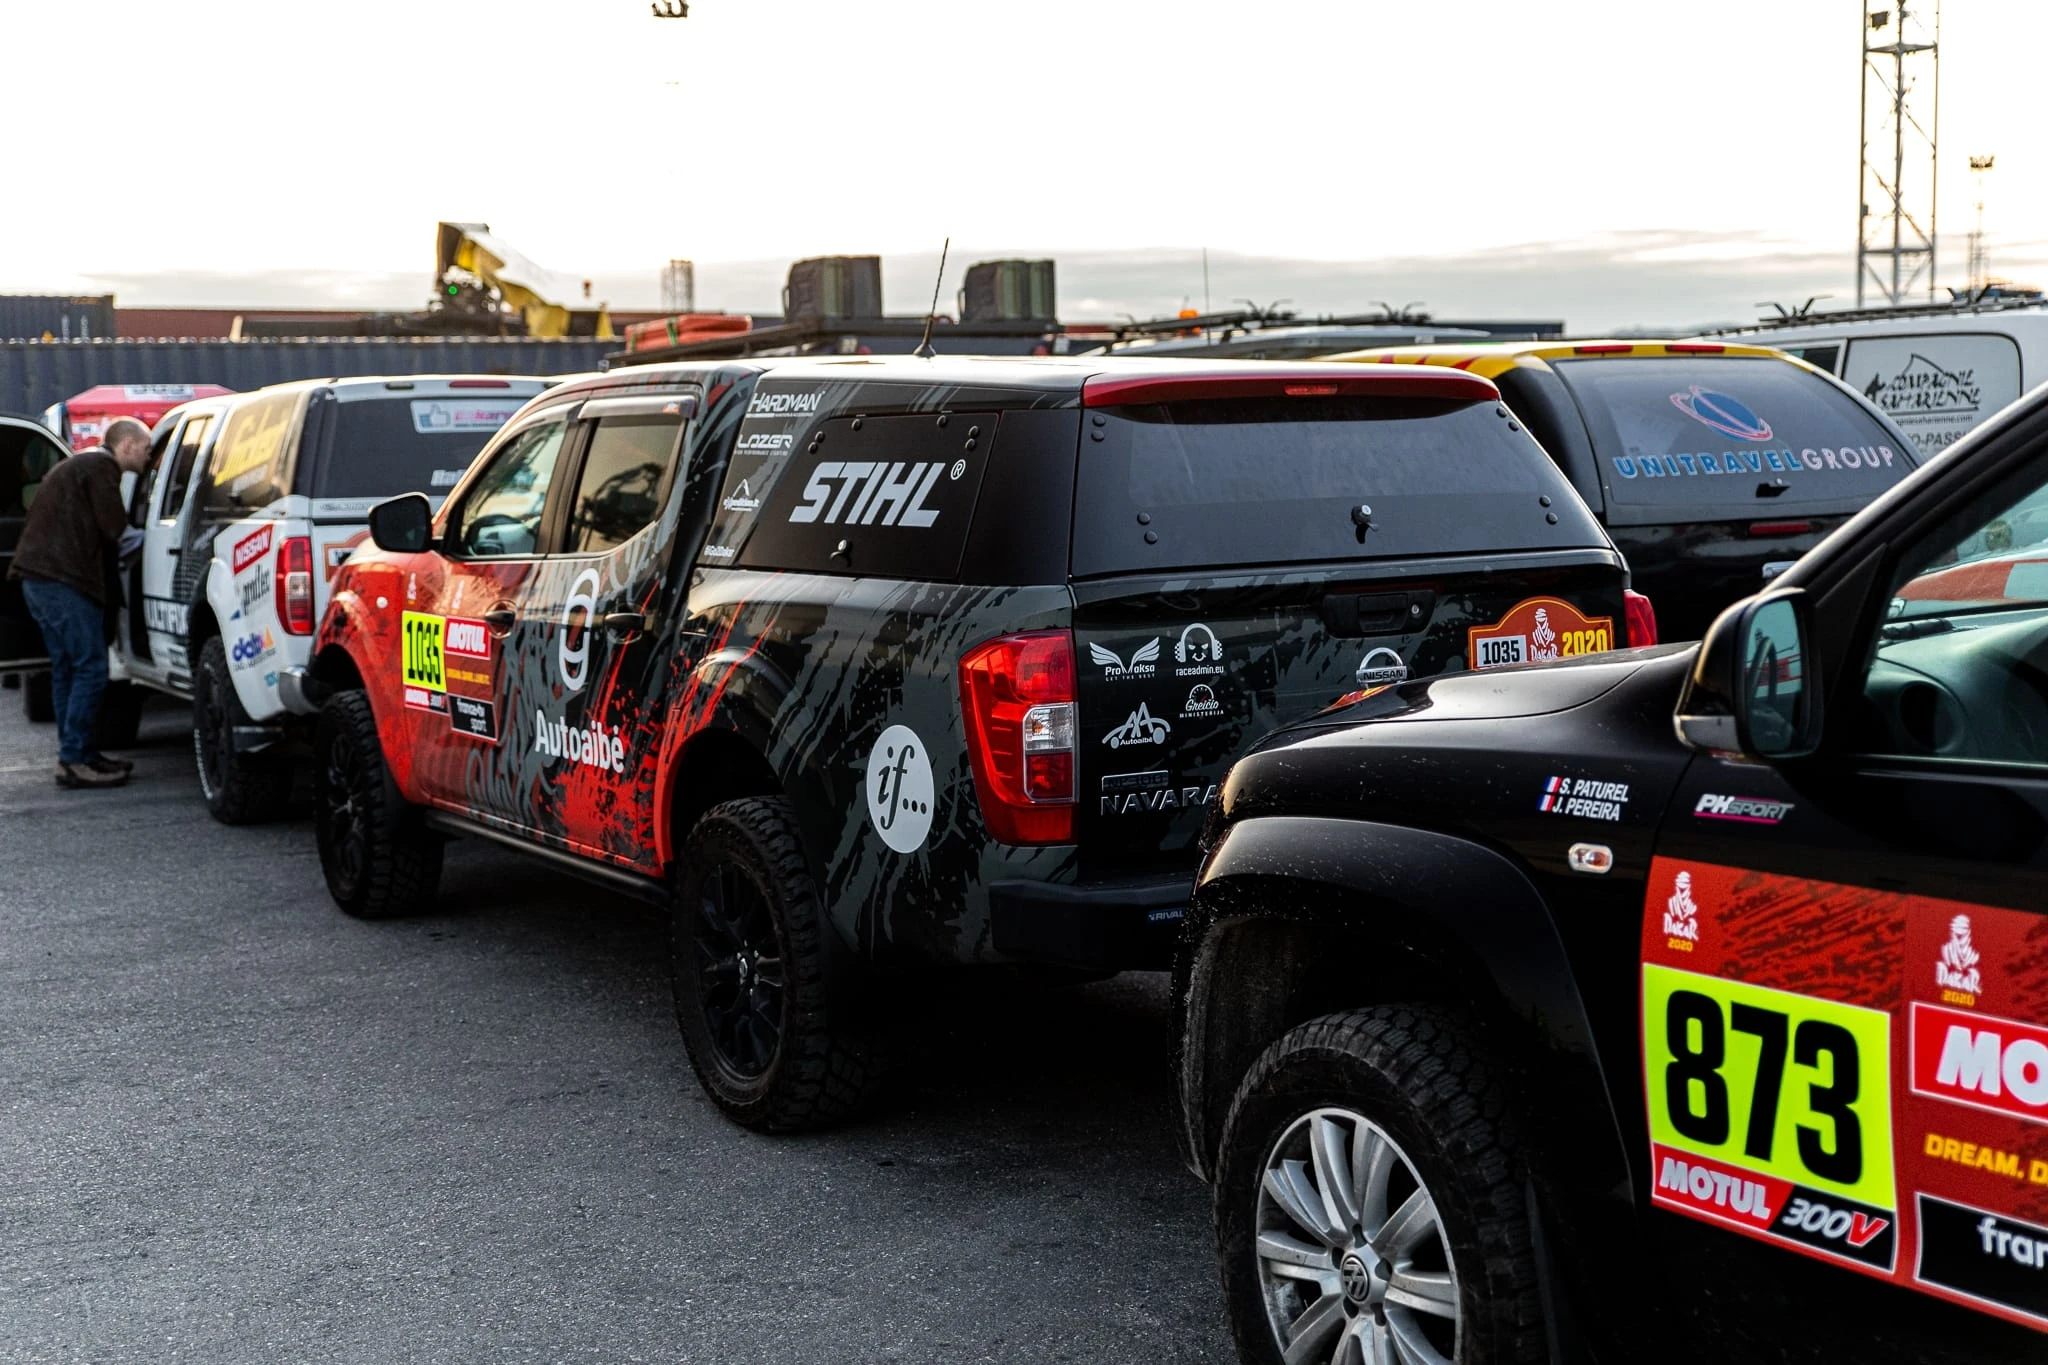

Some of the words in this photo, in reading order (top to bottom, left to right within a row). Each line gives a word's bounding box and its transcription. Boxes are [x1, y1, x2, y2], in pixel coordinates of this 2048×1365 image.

[747, 391, 822, 412] HARDMAN
[788, 462, 946, 528] STIHL
[406, 619, 441, 685] 1035
[446, 622, 486, 653] MOTUL
[1482, 639, 1520, 665] 1035
[1562, 628, 1607, 658] 2020
[1176, 665, 1225, 677] raceadmin.eu
[1362, 669, 1404, 681] NISSAN
[1180, 709, 1224, 718] MINISTERIJA
[535, 709, 624, 773] Autoaibė
[1559, 777, 1571, 795] S.
[1573, 779, 1629, 802] PATUREL
[1552, 797, 1563, 814] J.
[1565, 798, 1620, 821] PEREIRA
[1667, 937, 1693, 952] 2020
[1942, 990, 1976, 1007] 2020
[1665, 989, 1863, 1186] 873
[1924, 1133, 2025, 1180] DREAM.
[1659, 1156, 1772, 1221] MOTUL
[1780, 1197, 1890, 1248] 300V
